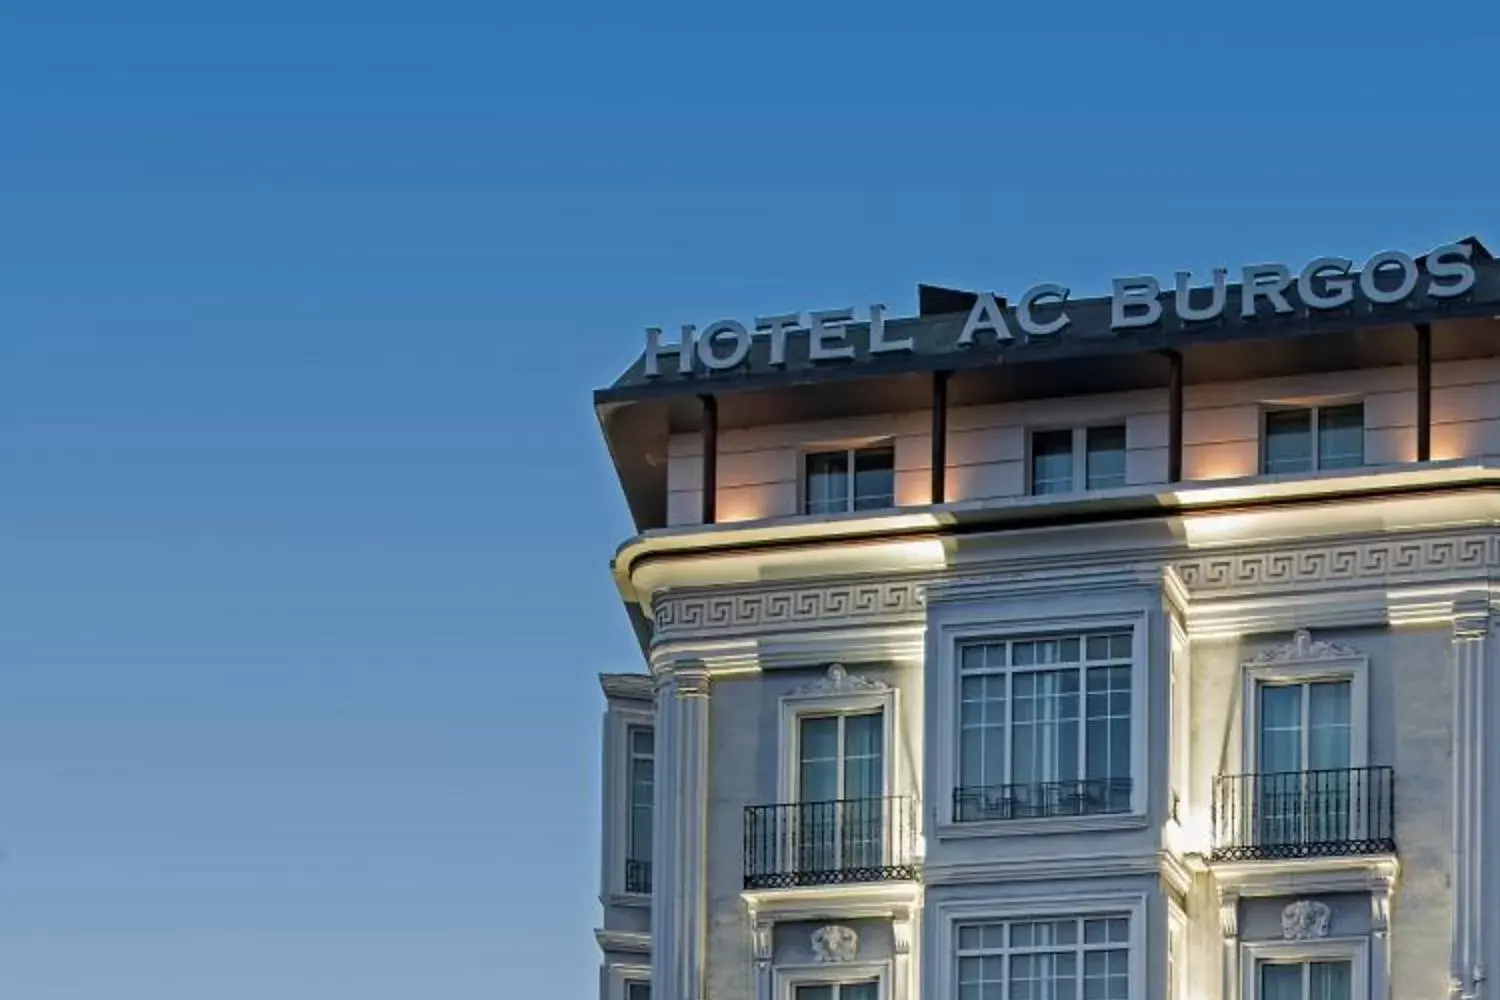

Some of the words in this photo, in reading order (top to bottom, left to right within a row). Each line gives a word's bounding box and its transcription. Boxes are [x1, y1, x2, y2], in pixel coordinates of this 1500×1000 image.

[644, 304, 913, 377] HOTEL
[957, 282, 1071, 345] AC
[1110, 244, 1477, 330] BURGOS
